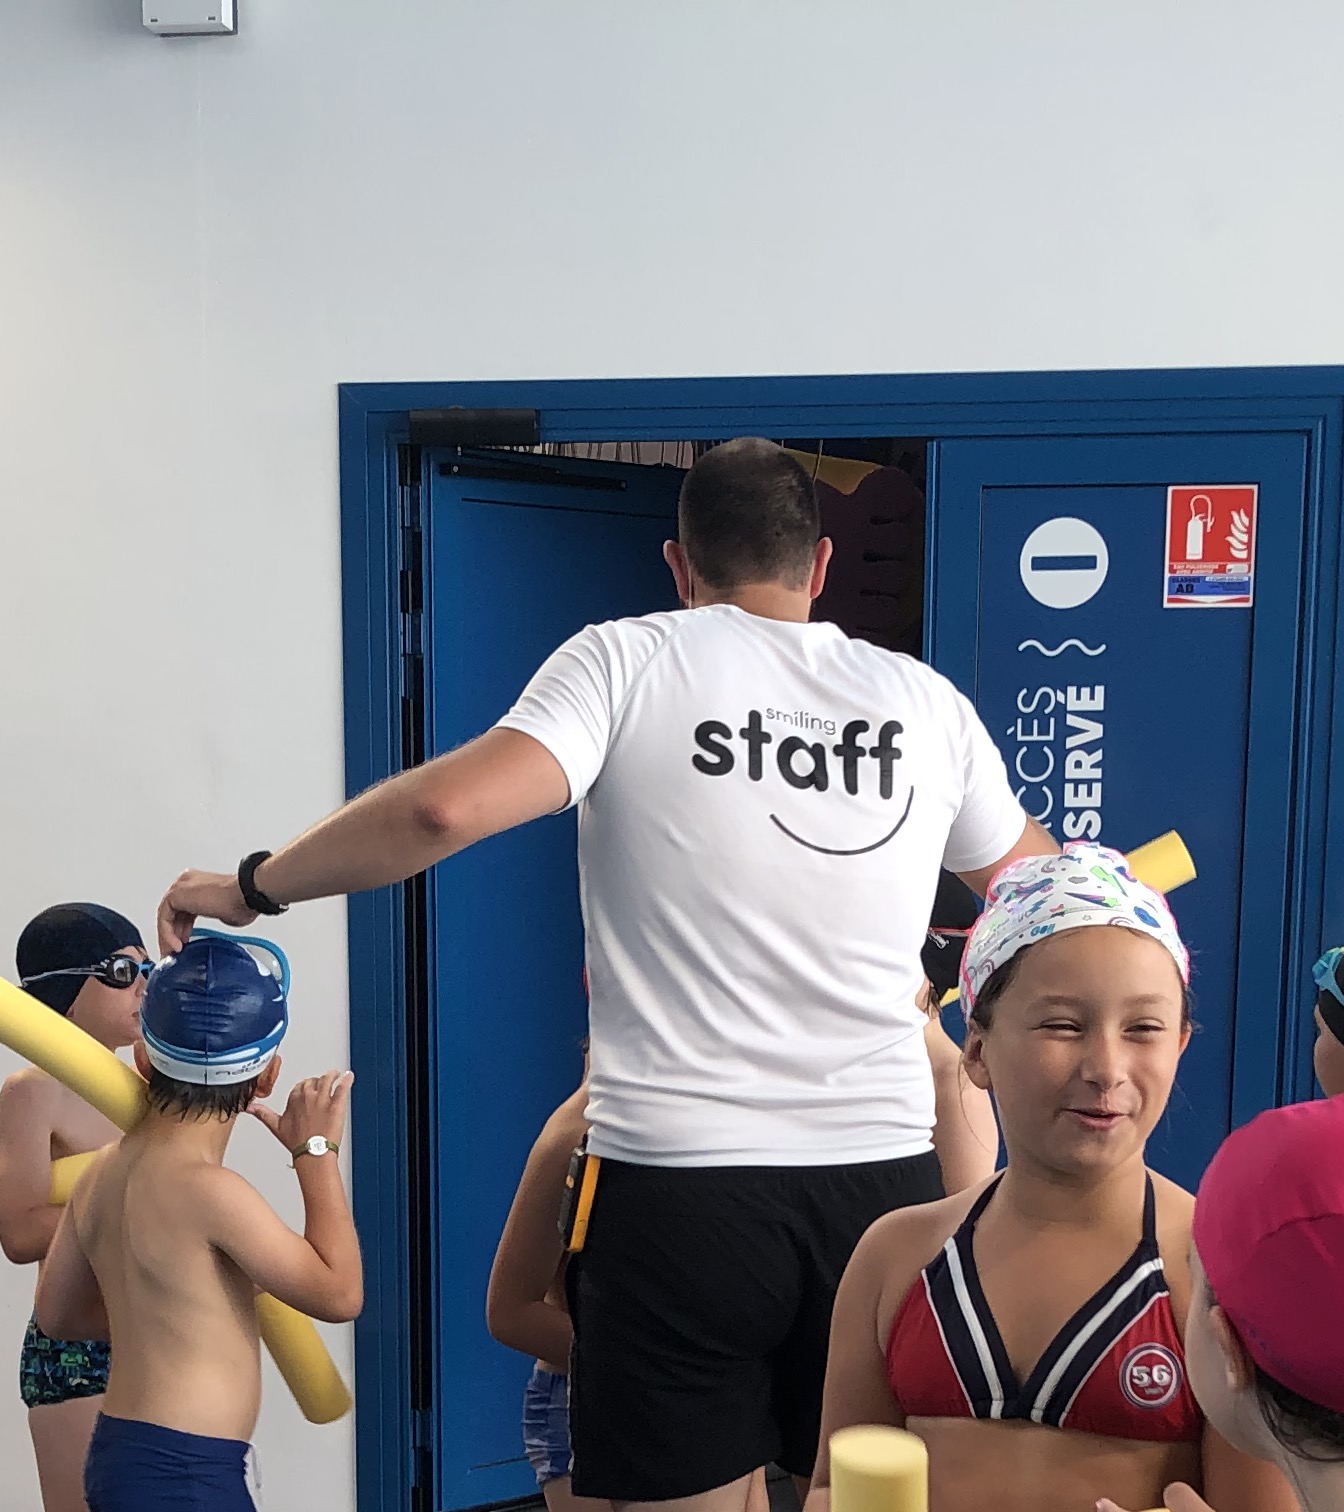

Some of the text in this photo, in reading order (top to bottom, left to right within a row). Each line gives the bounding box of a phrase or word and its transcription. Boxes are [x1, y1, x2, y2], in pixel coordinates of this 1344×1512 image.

[692, 709, 904, 800] staff
[765, 707, 837, 736] smiling
[1006, 686, 1056, 829] CCÈS
[1056, 684, 1105, 845] SERVÉ
[1132, 1364, 1172, 1388] 56
